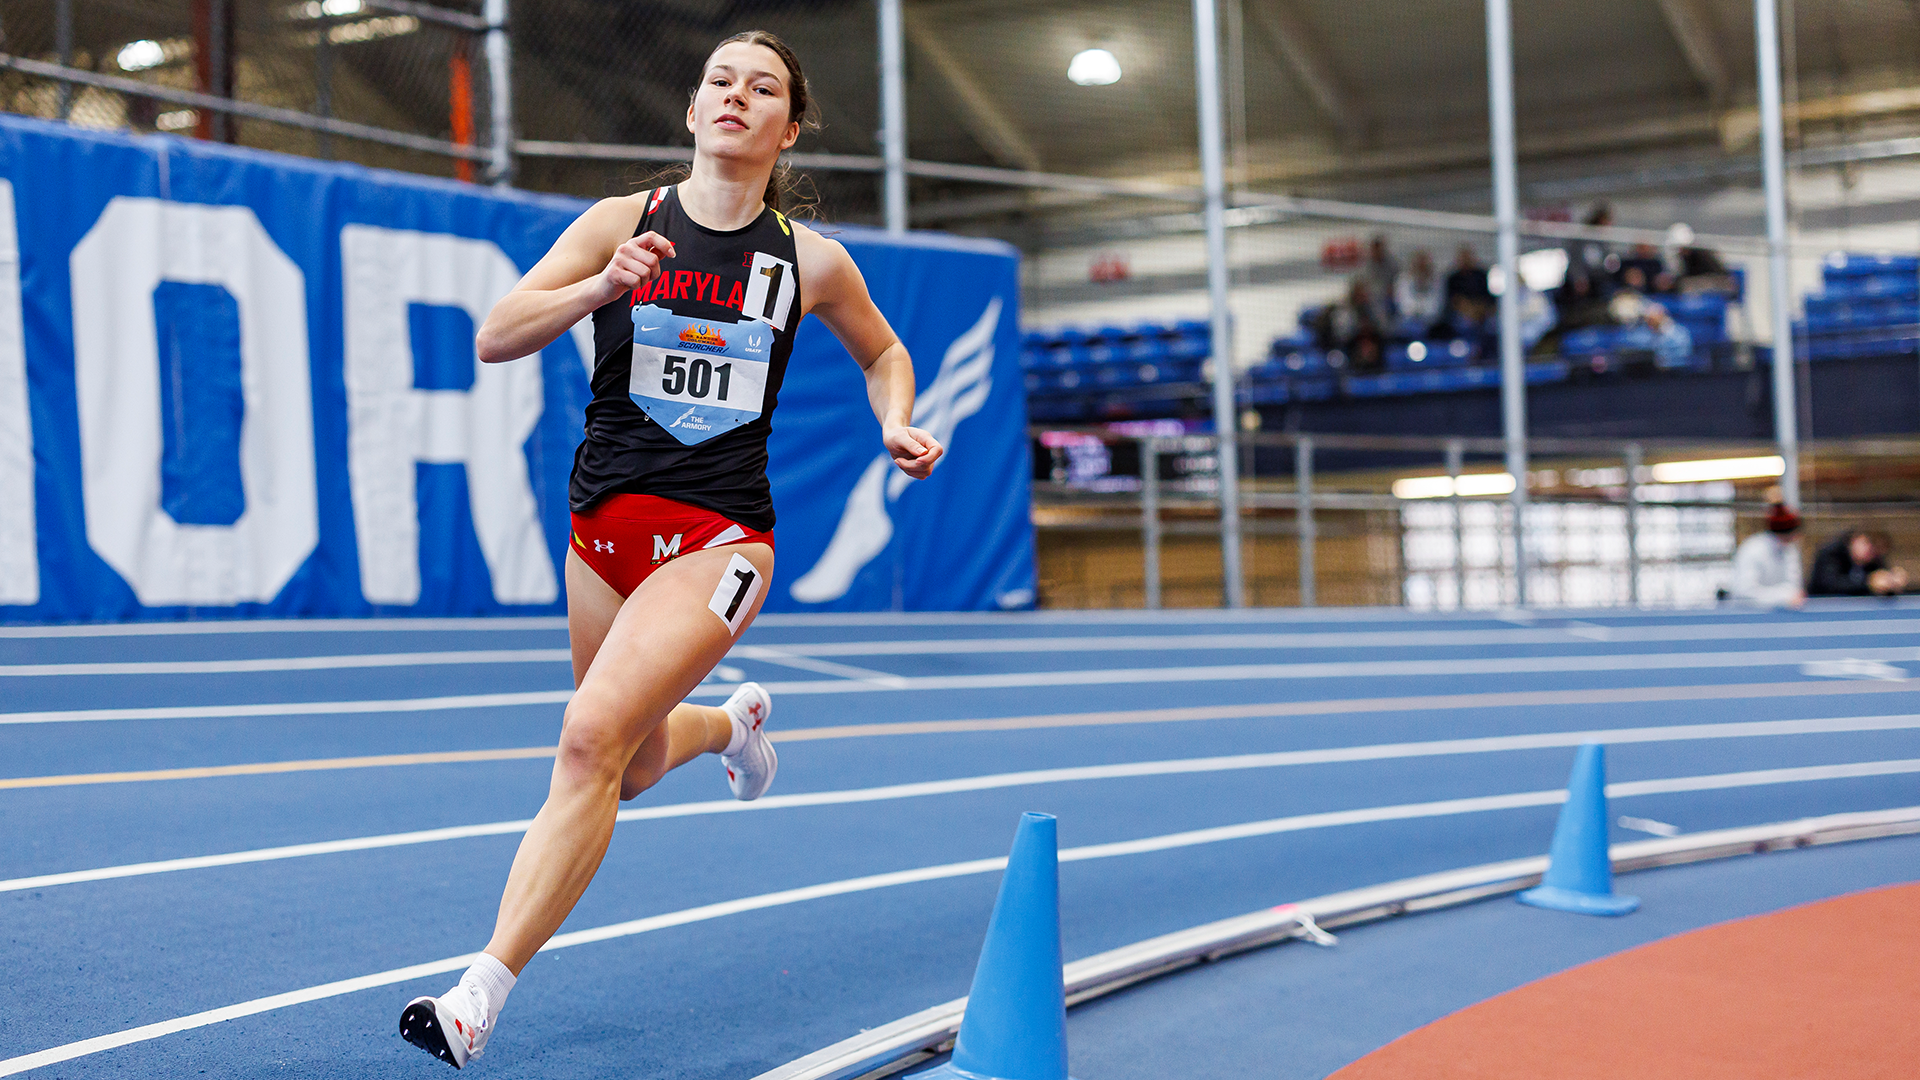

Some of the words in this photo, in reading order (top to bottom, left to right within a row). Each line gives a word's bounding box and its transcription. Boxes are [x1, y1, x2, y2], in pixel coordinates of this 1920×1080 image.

[629, 270, 744, 312] MARYLA
[760, 263, 784, 320] 1
[0, 178, 594, 606] OR
[662, 355, 731, 401] 501
[681, 422, 711, 431] ARMORY
[691, 416, 704, 424] THE
[652, 534, 682, 560] M
[724, 568, 756, 623] 1
